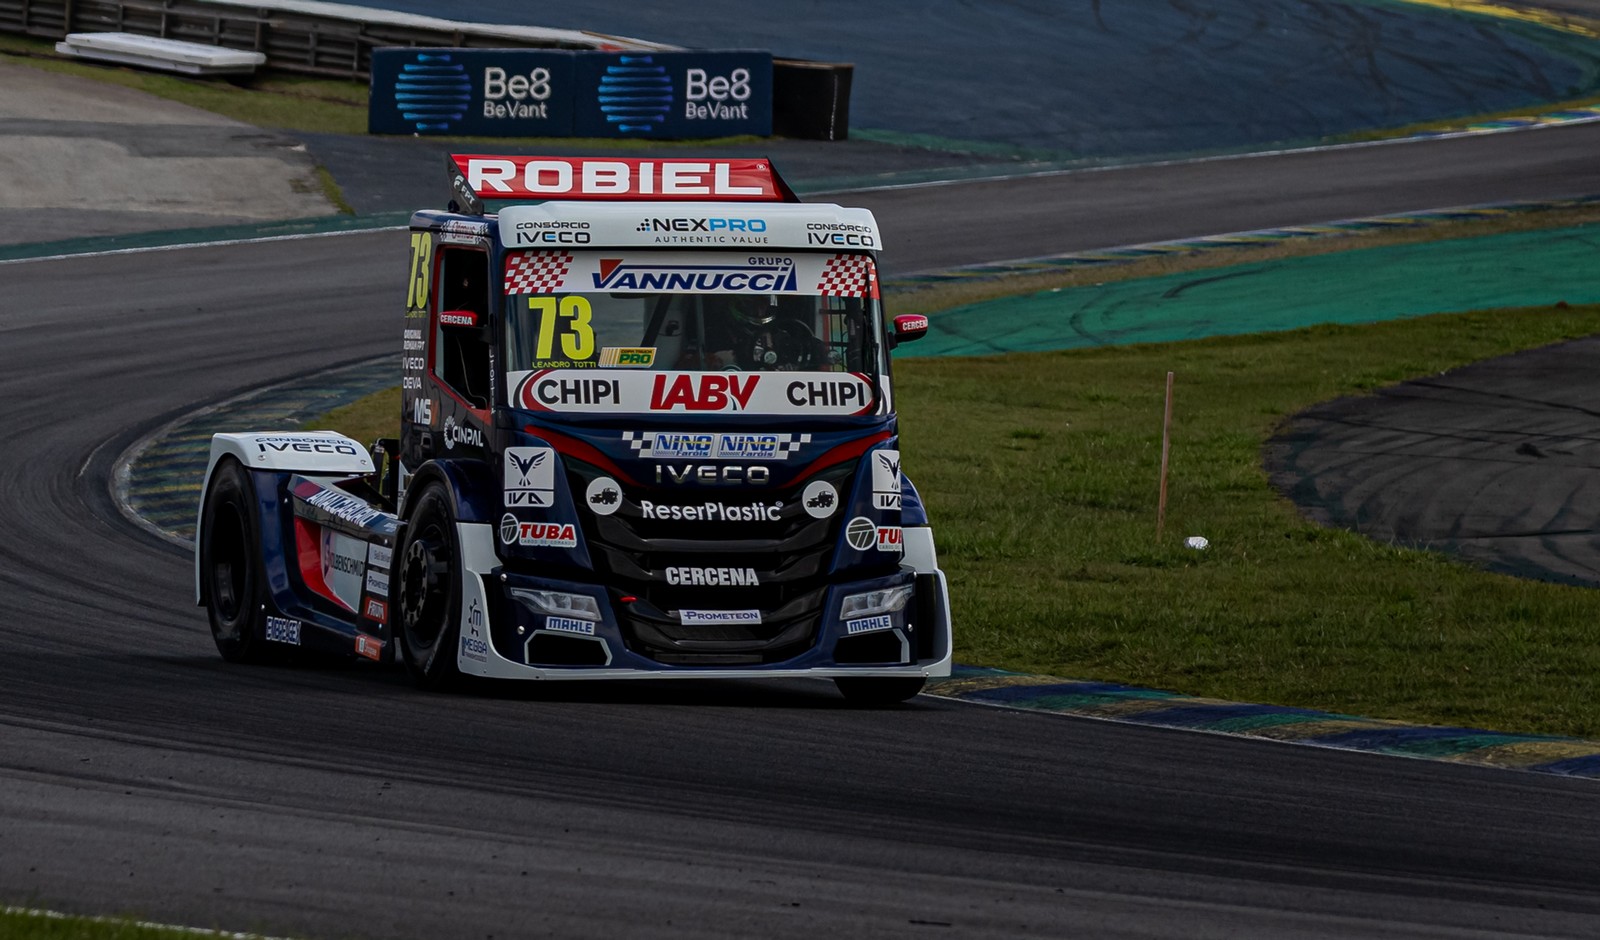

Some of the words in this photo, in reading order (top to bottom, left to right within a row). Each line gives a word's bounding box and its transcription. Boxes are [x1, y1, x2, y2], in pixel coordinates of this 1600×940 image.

[484, 67, 551, 100] Be8
[685, 68, 751, 100] Be8
[483, 102, 547, 119] BeVant
[685, 102, 749, 120] BeVant
[468, 159, 763, 195] ROBIEL
[516, 220, 591, 230] CONSÓRCIO
[652, 218, 767, 233] NEXPRO
[517, 232, 591, 244] IVECO
[654, 236, 727, 244] AUTHENTIC
[731, 236, 769, 244] VALUE
[808, 234, 874, 247] IVECO
[748, 257, 793, 267] GRUPO
[406, 232, 432, 309] 73
[440, 314, 473, 326] CERCENA
[528, 295, 595, 360] 73
[402, 357, 424, 370] IVECO
[532, 361, 570, 369] LEANDRO
[619, 353, 651, 364] PRO
[403, 377, 422, 389] DEVA
[537, 379, 620, 404] CHIPI
[786, 380, 866, 407] CHIPI
[452, 425, 484, 447] CINPAL
[258, 442, 357, 456] IVECO
[655, 464, 770, 485] IVECO
[880, 495, 901, 507] IV
[640, 500, 782, 521] ReserPlastic
[520, 524, 574, 540] TUBA
[665, 566, 760, 587] CERCENA
[684, 611, 758, 620] PROMETEON
[549, 617, 592, 633] MAHLE
[850, 616, 890, 632] MAHLE
